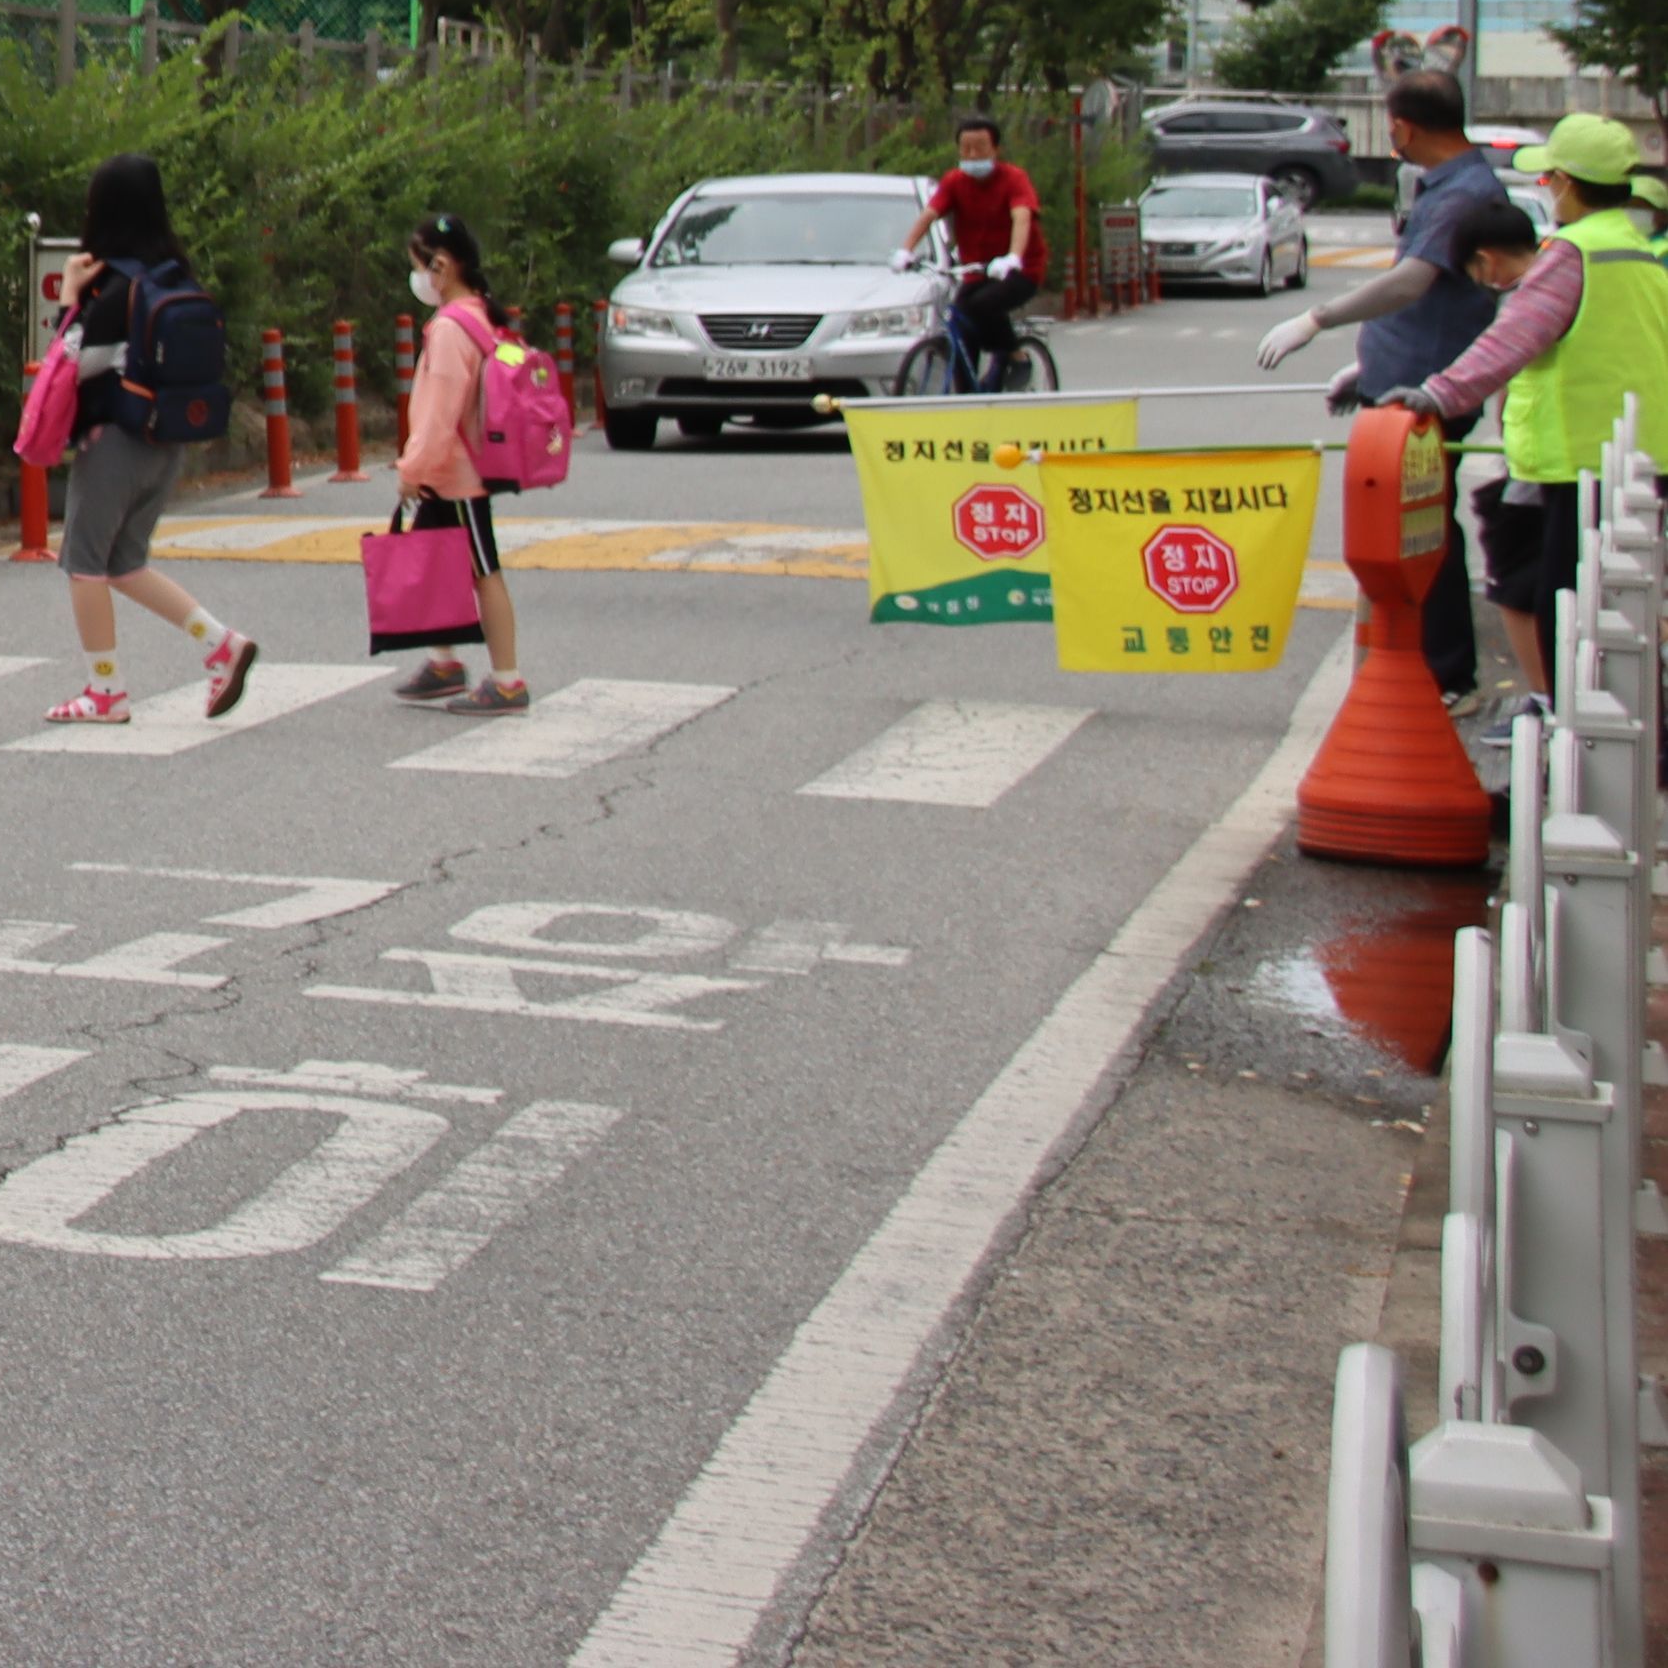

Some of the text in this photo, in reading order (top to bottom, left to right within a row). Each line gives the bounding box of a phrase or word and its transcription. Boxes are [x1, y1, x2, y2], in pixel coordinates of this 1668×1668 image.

[1068, 483, 1288, 515] 정지선을 지킵시다
[1167, 575, 1219, 595] STOP
